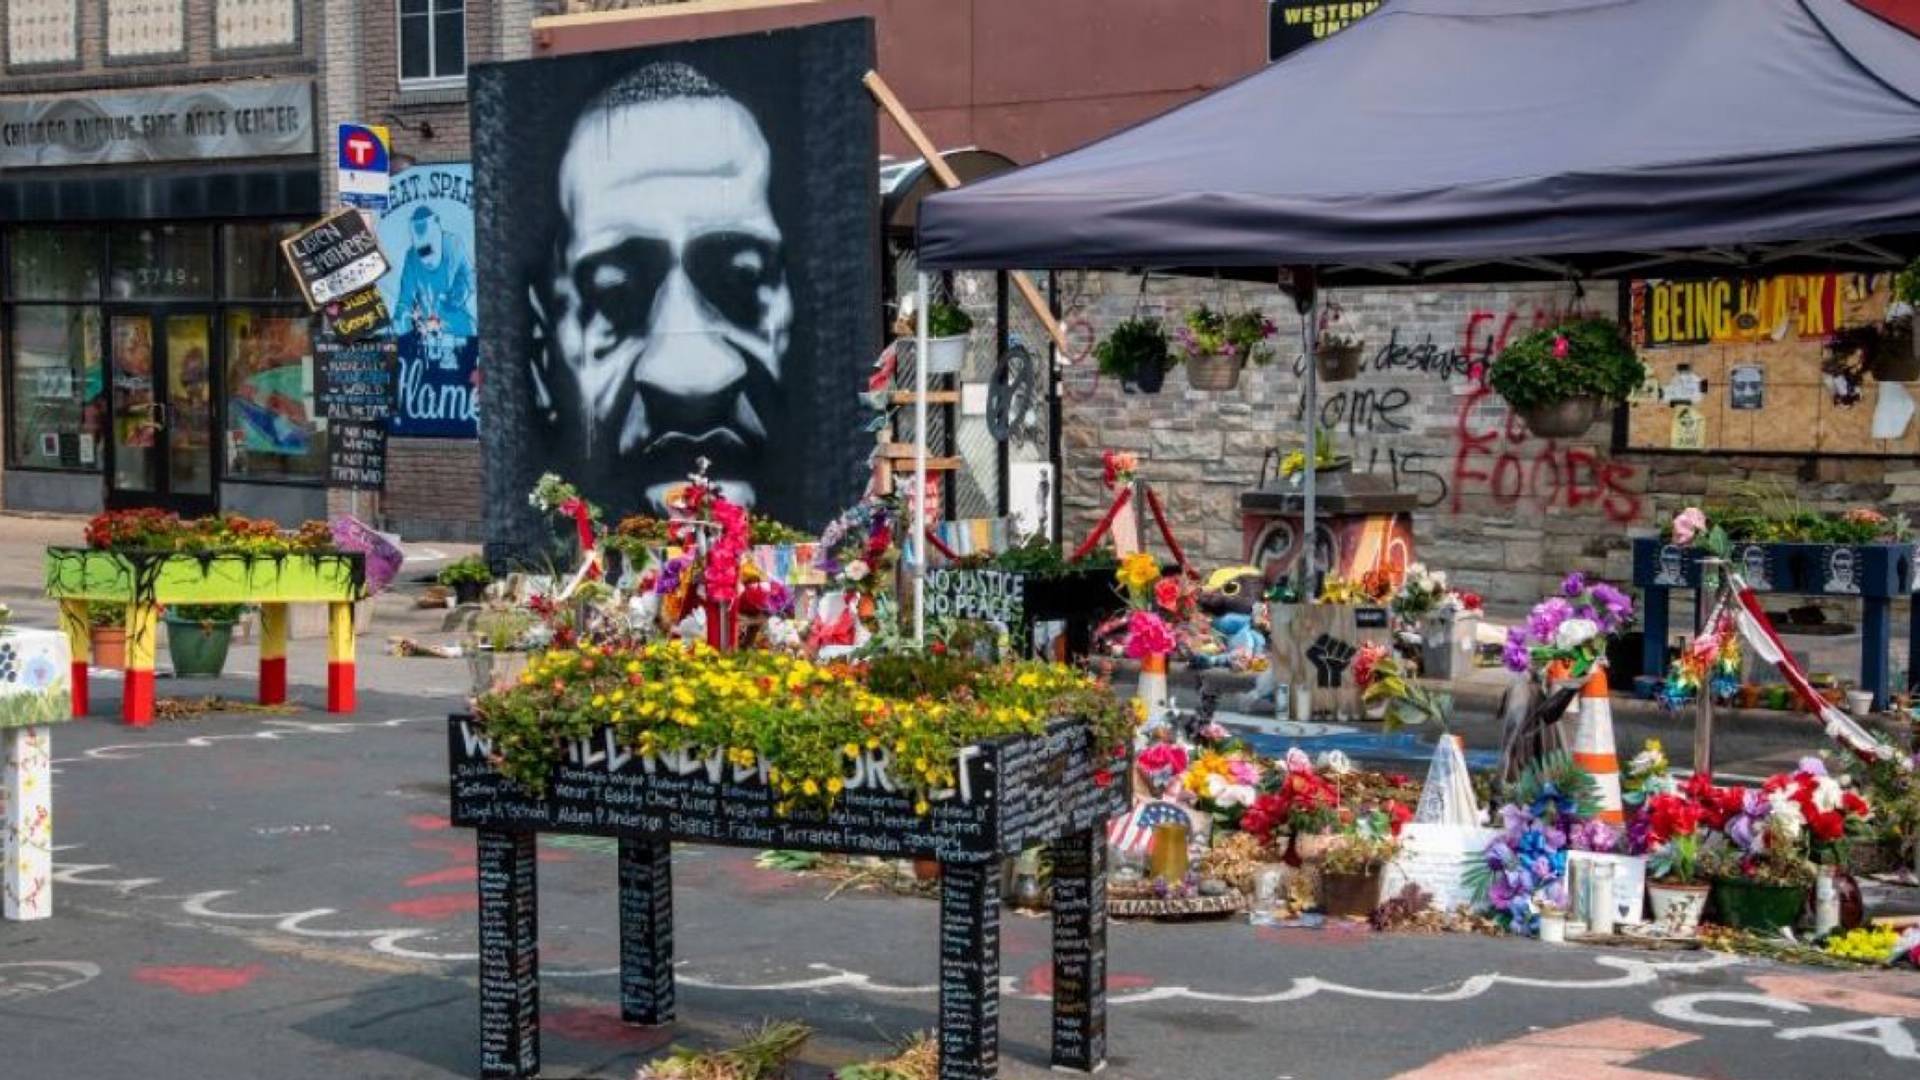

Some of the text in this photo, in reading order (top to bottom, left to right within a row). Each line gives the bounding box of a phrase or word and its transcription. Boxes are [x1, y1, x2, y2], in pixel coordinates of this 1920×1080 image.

[1312, 19, 1350, 38] UN
[185, 109, 227, 136] ARTS
[234, 104, 300, 135] CENTER
[347, 139, 373, 165] T
[1652, 279, 1732, 343] BEING
[1297, 386, 1412, 438] ome
[1451, 438, 1642, 523] FOODS
[925, 569, 1025, 601] NO JUSTICE
[925, 594, 1013, 623] NO PEACE
